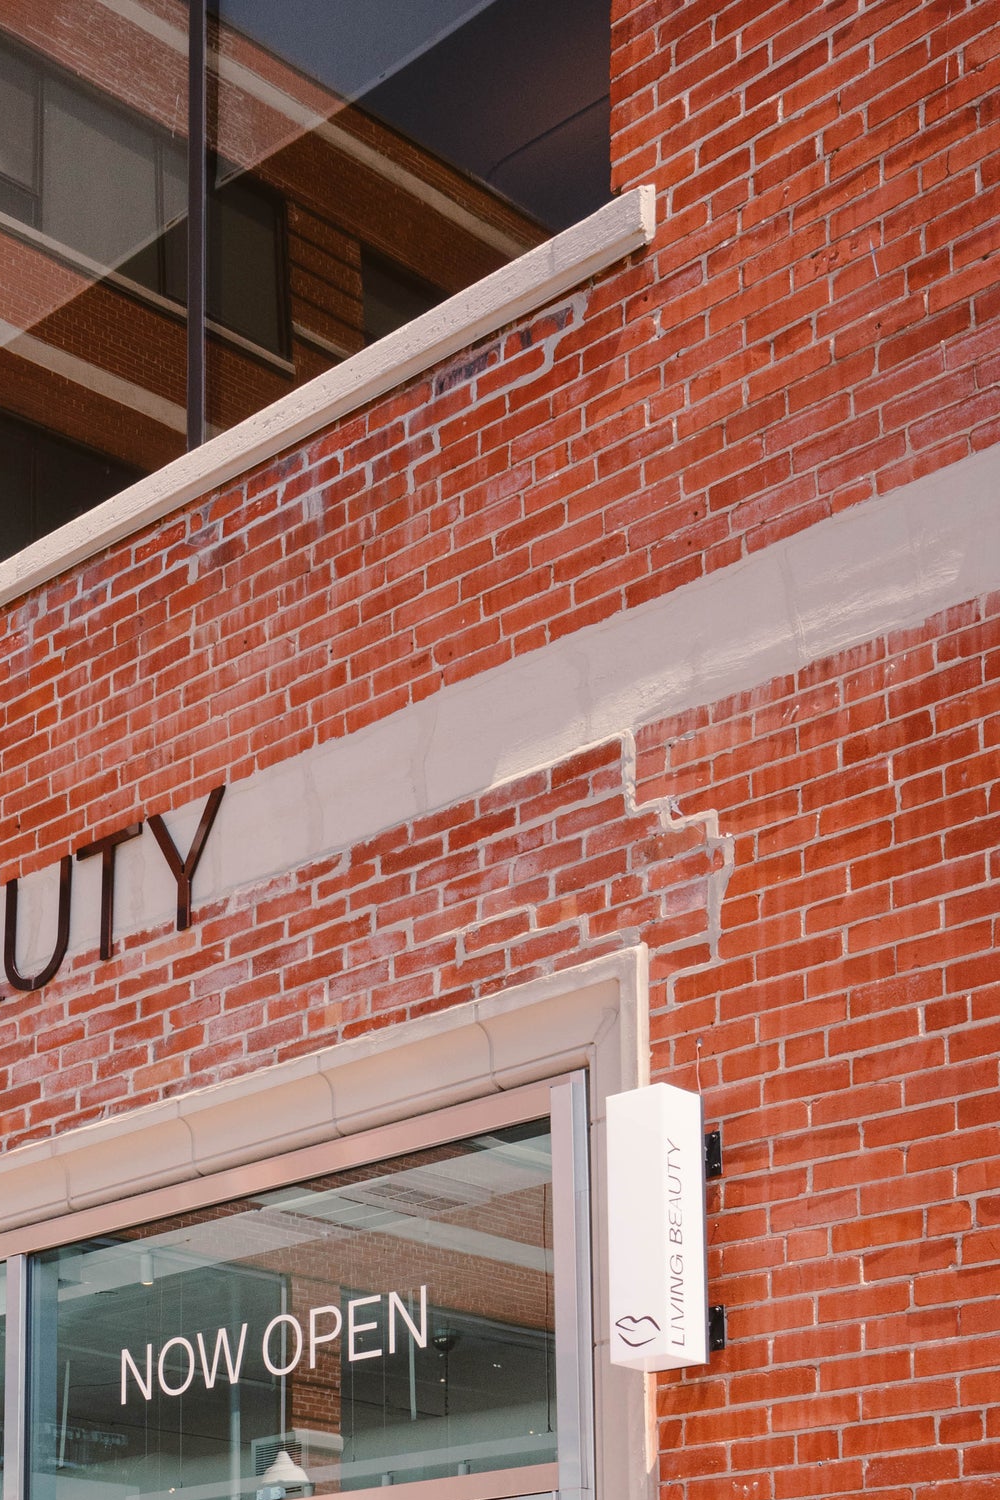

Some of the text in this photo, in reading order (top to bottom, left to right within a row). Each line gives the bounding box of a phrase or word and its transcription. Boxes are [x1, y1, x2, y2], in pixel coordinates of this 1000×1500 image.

[667, 1138, 685, 1346] LIVING BEAUTY
[121, 1285, 427, 1405] NOW OPEN
